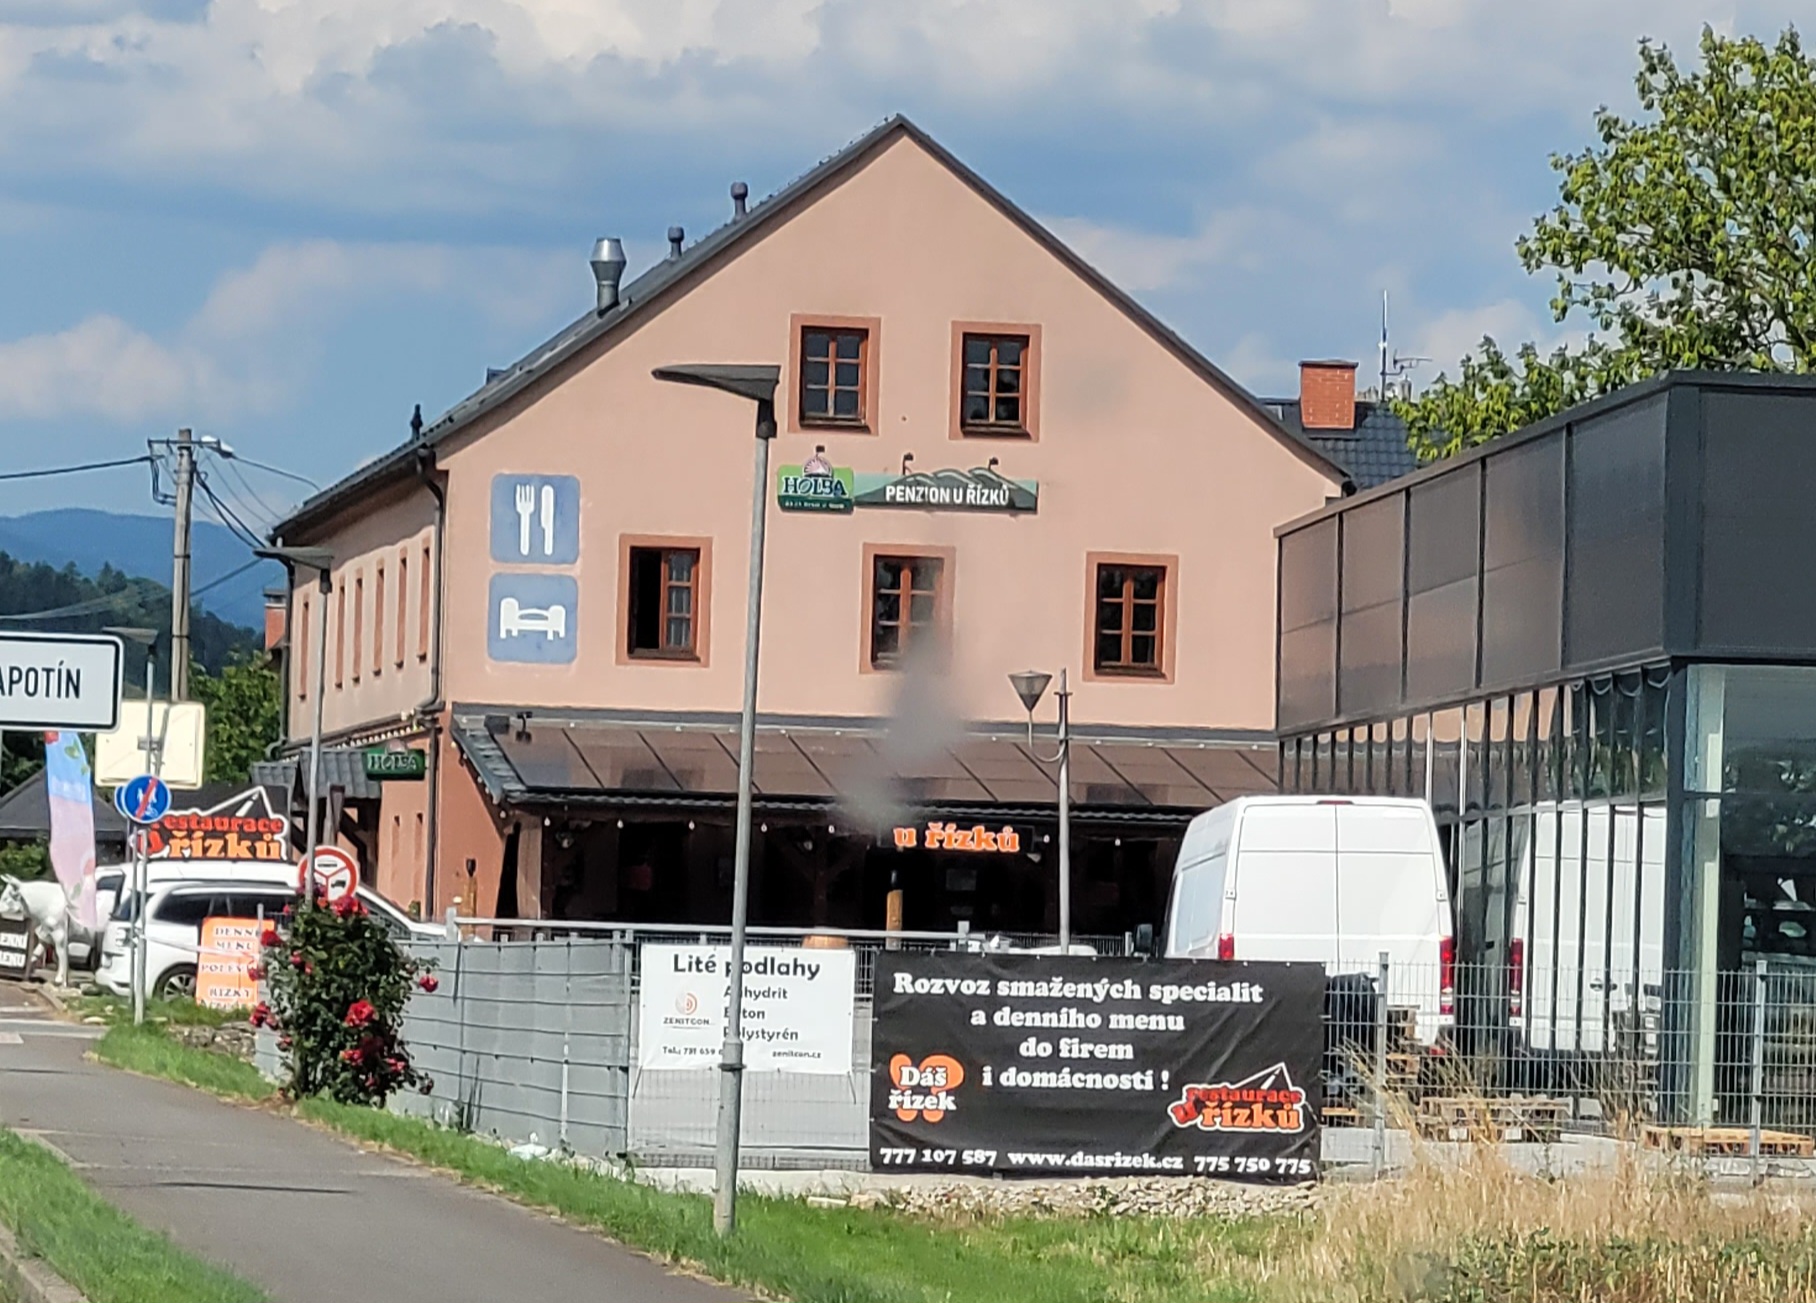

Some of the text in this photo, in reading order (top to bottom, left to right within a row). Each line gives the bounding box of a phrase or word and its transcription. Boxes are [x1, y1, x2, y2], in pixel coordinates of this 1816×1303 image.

[782, 476, 848, 497] HOLBA
[885, 483, 1009, 505] PENZION U ŘÍZKŮ
[168, 830, 281, 860] řízků
[893, 822, 1019, 852] u řízků
[673, 954, 821, 980] Lité podlahy
[723, 985, 788, 1001] Ahydrit
[893, 972, 1264, 1005] Rozvoz smažených specialit
[663, 1017, 710, 1026] ZENITCON
[723, 1006, 766, 1020] Bton
[970, 1006, 1185, 1031] a denního menu
[723, 1026, 799, 1042] Plystyrén
[1019, 1037, 1134, 1060] do firem
[900, 1066, 947, 1087] Dáš
[981, 1066, 993, 1086] i
[1000, 1067, 1154, 1091] domácností
[888, 1089, 957, 1111] řízek
[1186, 1086, 1303, 1103] restaurace
[1201, 1101, 1300, 1130] řízků
[880, 1148, 1312, 1175] 777 107 587 www.dasrizek.cz 775 750 775
